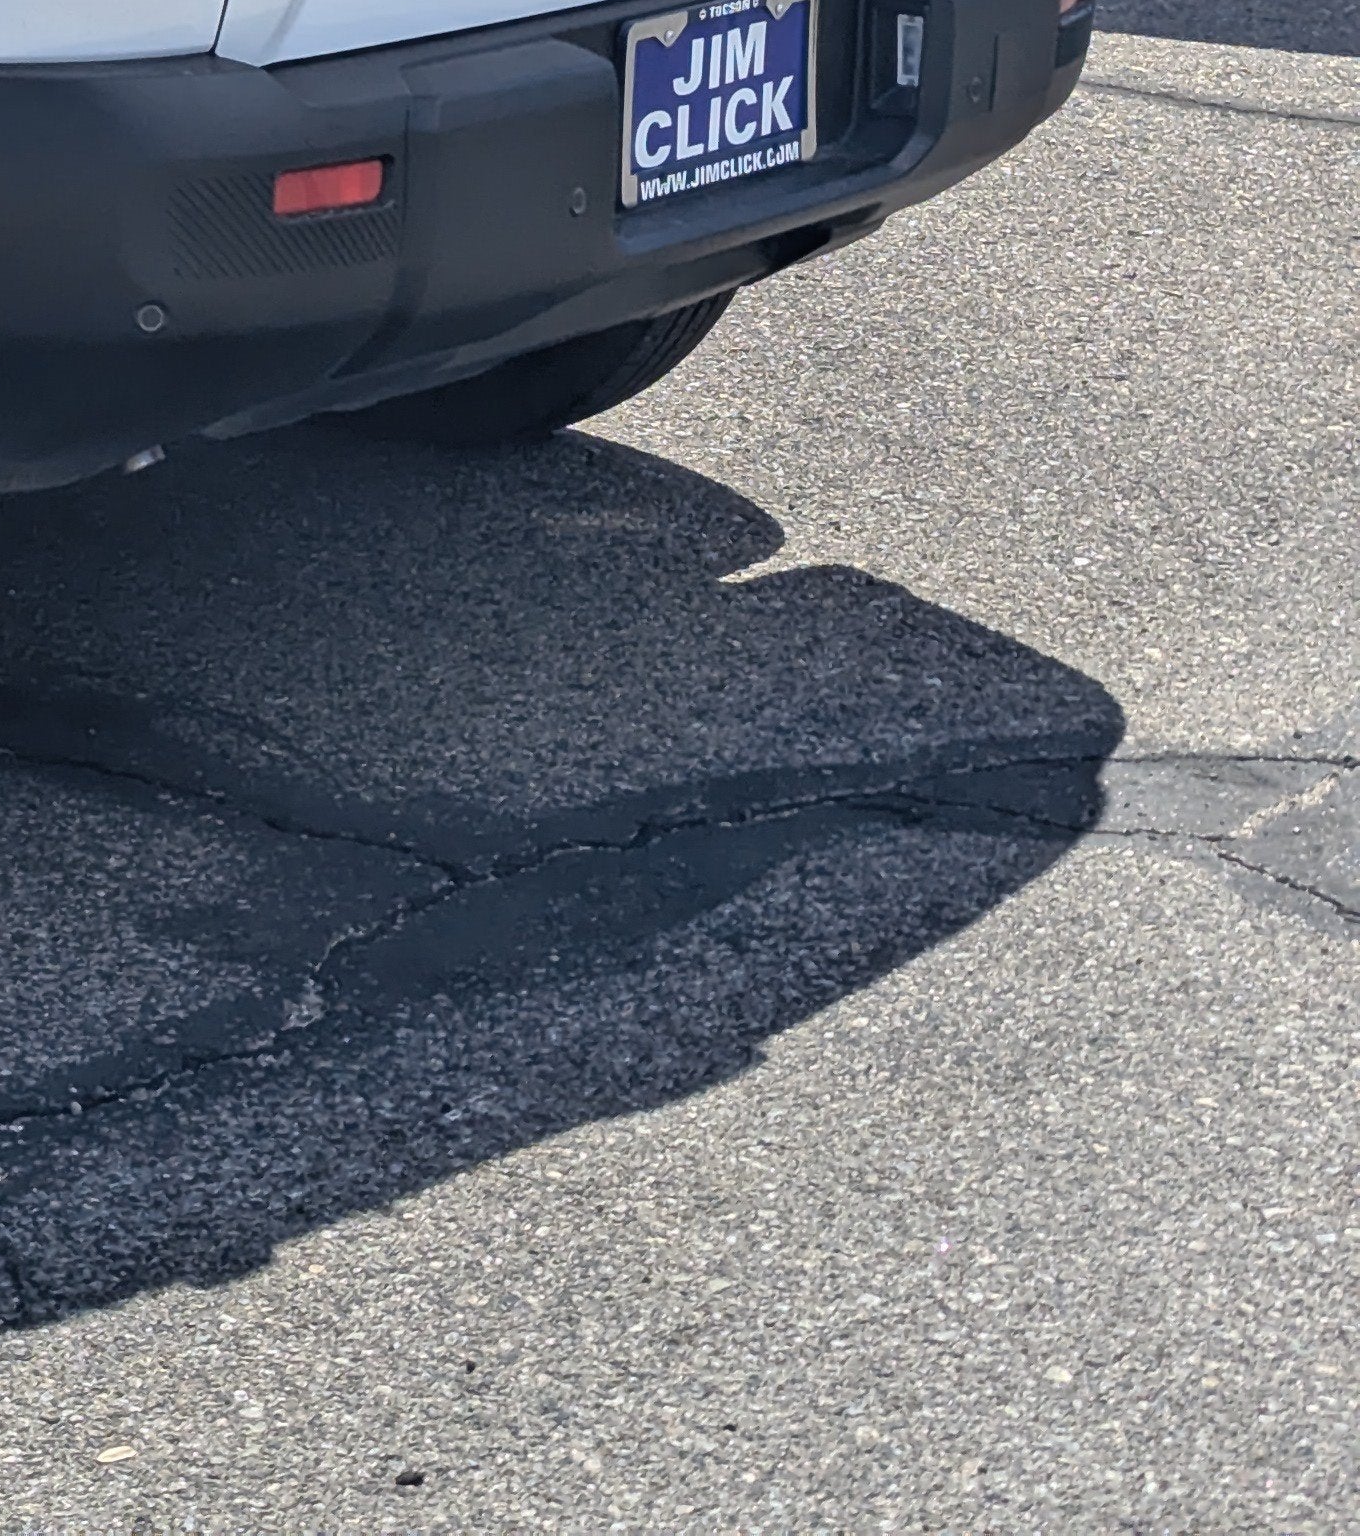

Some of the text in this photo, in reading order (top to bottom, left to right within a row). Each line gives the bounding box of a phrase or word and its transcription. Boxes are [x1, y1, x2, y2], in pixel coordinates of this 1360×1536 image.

[673, 21, 767, 96] JIM
[634, 75, 794, 169] CLICK
[640, 141, 800, 202] WWW.JIMCLICK.COM
